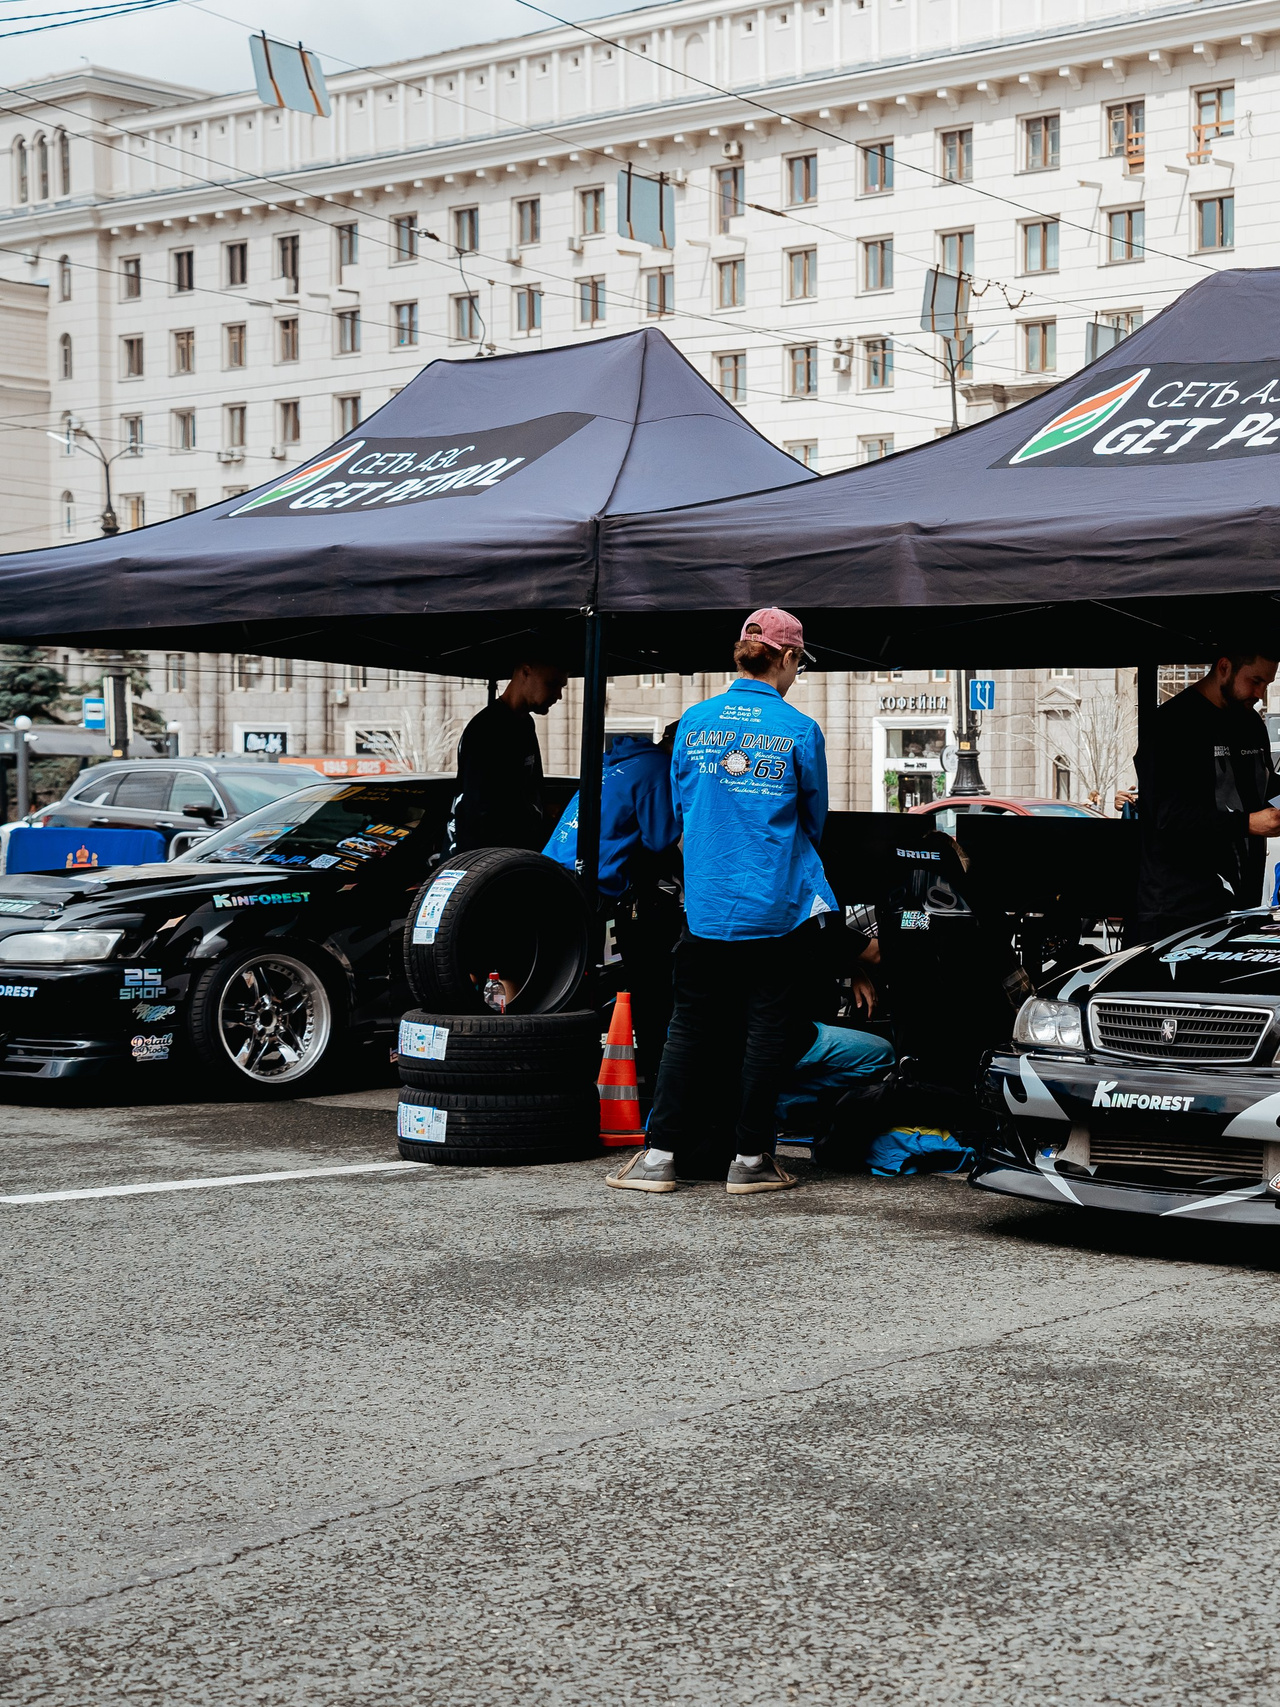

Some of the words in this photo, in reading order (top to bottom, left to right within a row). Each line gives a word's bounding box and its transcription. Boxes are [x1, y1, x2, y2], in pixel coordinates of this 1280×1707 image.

[1147, 380, 1240, 409] СЕТЬ
[1093, 417, 1227, 455] GET
[348, 452, 418, 475] СЕТЬ
[412, 445, 475, 472] АЗС
[289, 481, 394, 510] GET
[361, 457, 526, 506] PETROL
[879, 693, 948, 710] КОФЕЙНЯ
[686, 731, 736, 747] CAMP
[741, 733, 794, 753] DAVID
[753, 759, 786, 780] 63
[896, 848, 941, 860] BRIDE
[212, 891, 310, 909] KINFOREST
[119, 987, 167, 1000] SHOP
[131, 1033, 173, 1047] Detail
[1092, 1081, 1195, 1111] KINFOREST
